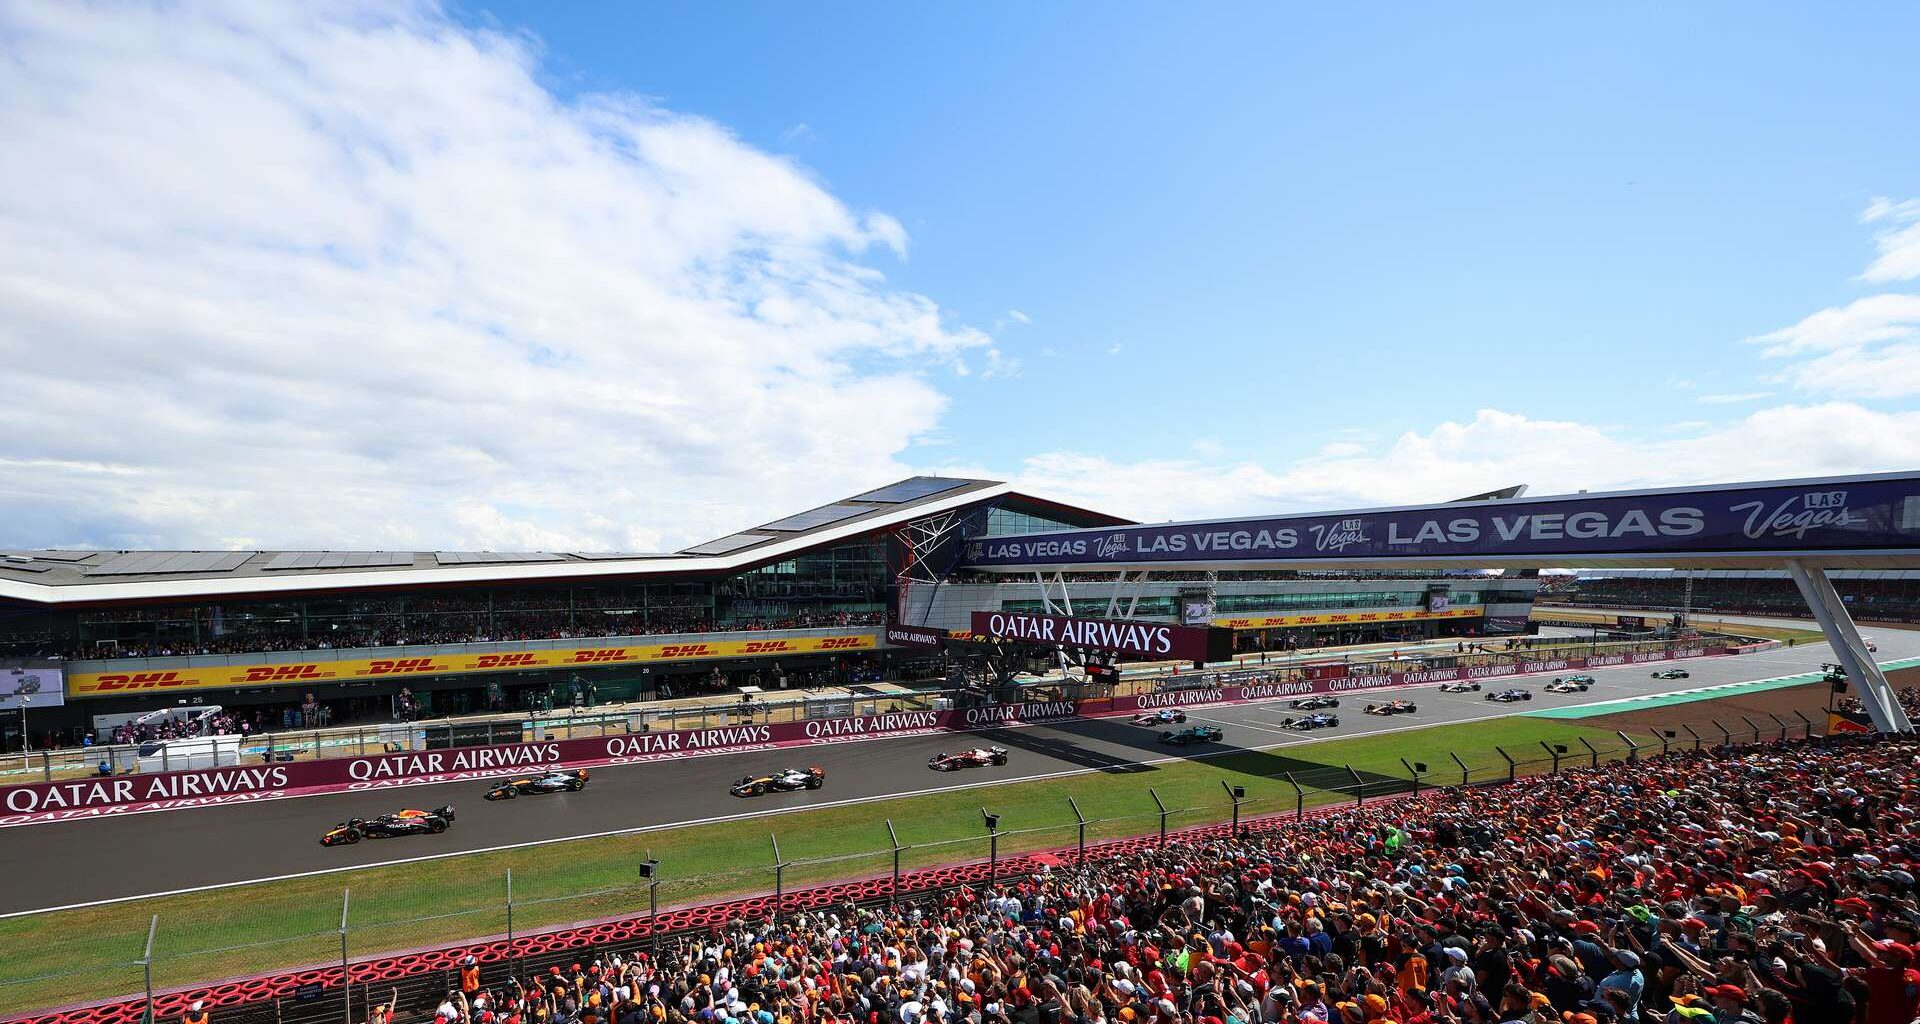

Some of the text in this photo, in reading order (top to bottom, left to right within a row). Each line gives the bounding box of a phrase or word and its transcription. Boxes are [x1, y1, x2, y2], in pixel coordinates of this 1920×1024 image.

[1808, 492, 1843, 507] LAS
[1388, 507, 1705, 545] LAS VEGAS
[1729, 497, 1869, 540] Vegas
[1137, 528, 1297, 553] LAS VEGAS
[1309, 522, 1370, 552] Vegas
[988, 544, 1021, 558] LAS
[1024, 540, 1087, 557] VEGAS
[1093, 536, 1130, 559] Vegas
[1264, 618, 1285, 626] DHL
[1299, 616, 1317, 624] DHL
[889, 630, 908, 640] QATAR
[910, 632, 936, 644] AIRWAYS
[990, 614, 1171, 654] QATAR AIRWAYS
[660, 644, 712, 658] DHL
[746, 640, 790, 654] DHL
[821, 638, 862, 649] DHL
[477, 654, 538, 668] DHL
[575, 649, 631, 662] DHL
[246, 665, 323, 682] DHL
[368, 658, 436, 674] DHL
[1468, 665, 1516, 678] QATAR AIRWAYS
[1524, 660, 1568, 672] QATAR AIRWAYS
[96, 672, 184, 691] DHL
[1329, 676, 1392, 691] QATAR AIRWAYS
[1403, 670, 1458, 684] QATAR AIRWAYS
[1138, 692, 1174, 709] QATAR
[1176, 688, 1224, 706] AIRWAYS
[1241, 682, 1313, 699] QATAR AIRWAYS
[966, 706, 1014, 724] QATAR
[1018, 701, 1074, 720] AIRWAYS
[806, 712, 937, 738] QATAR AIRWAYS
[606, 725, 770, 756] QATAR AIRWAYS
[349, 743, 560, 781] QATAR AIRWAYS
[349, 764, 563, 788] QATAR AIRWAYS
[7, 766, 288, 813] QATAR AIRWAYS
[0, 790, 286, 825] QATAR AIRWAYS
